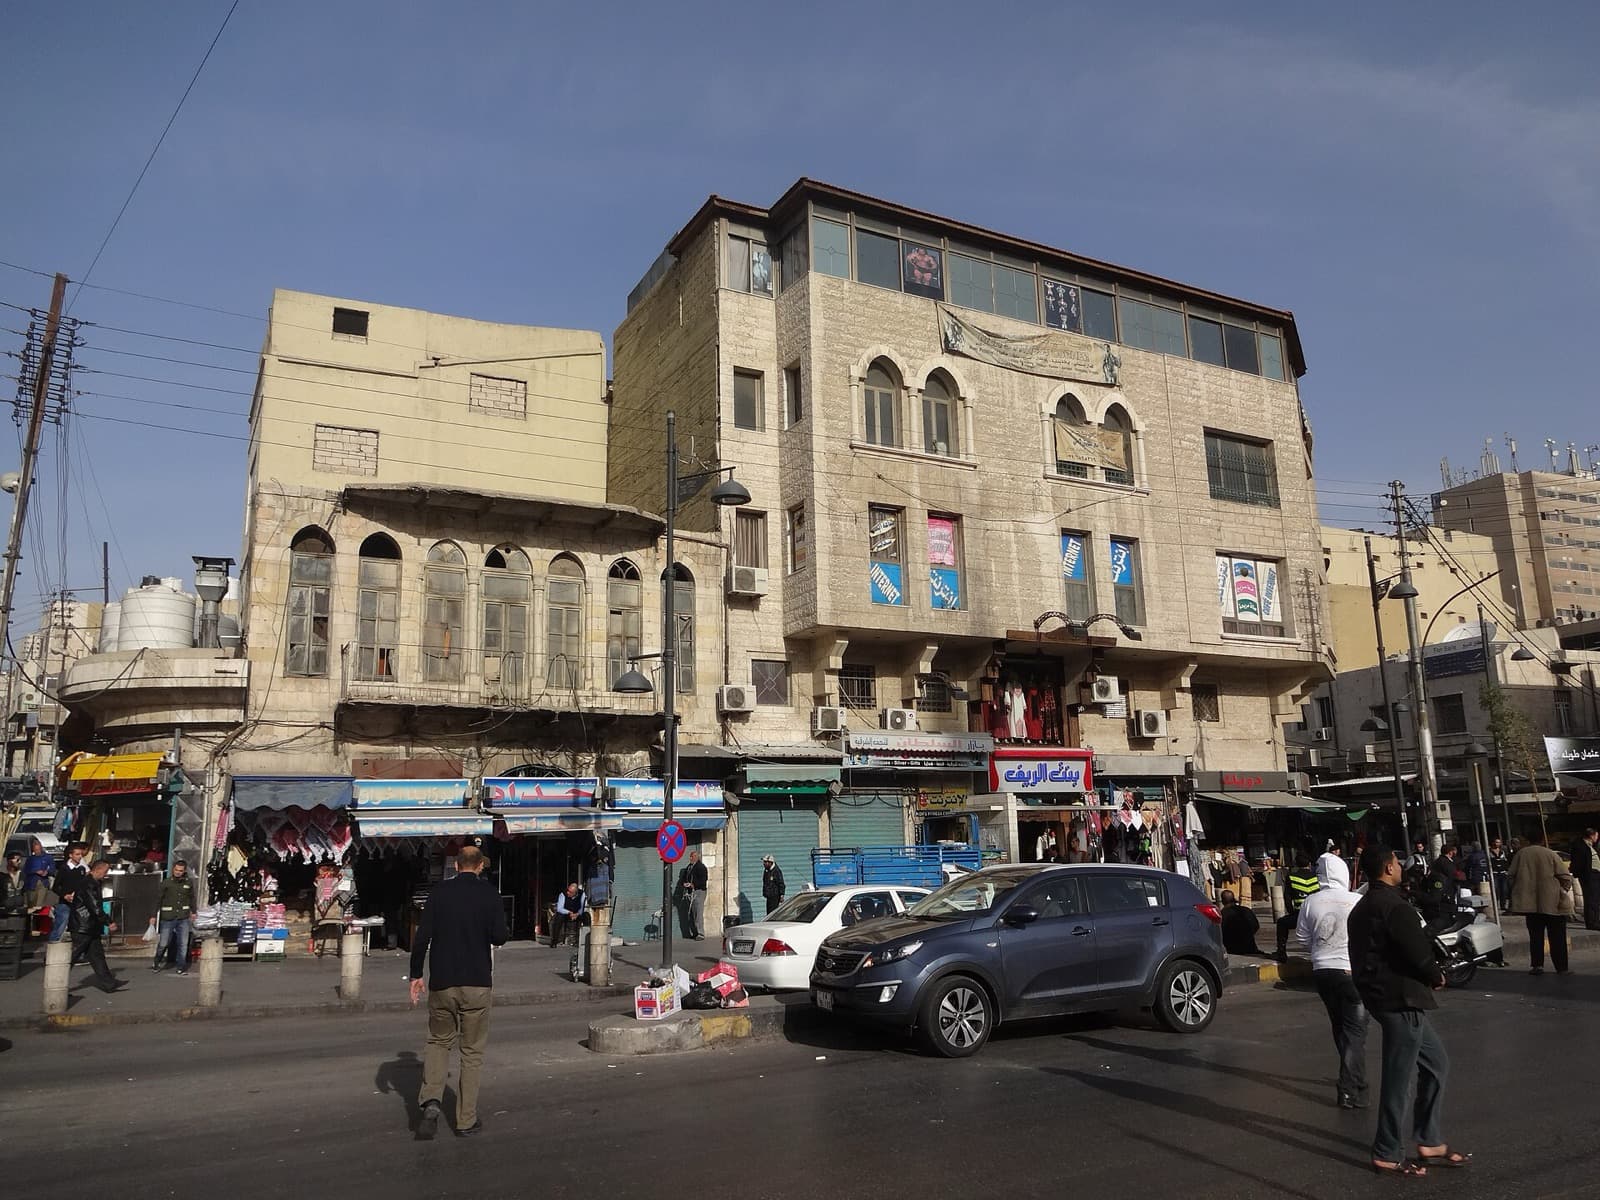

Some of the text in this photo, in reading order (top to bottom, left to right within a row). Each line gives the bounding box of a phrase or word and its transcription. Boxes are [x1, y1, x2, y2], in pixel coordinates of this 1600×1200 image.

[1063, 538, 1082, 577] INTERNET
[870, 563, 900, 604] INTERNET
[896, 737, 962, 748] السلطان
[967, 740, 985, 751] بازار
[1004, 761, 1080, 787] بنت الريف
[929, 794, 968, 808] الانترنت
